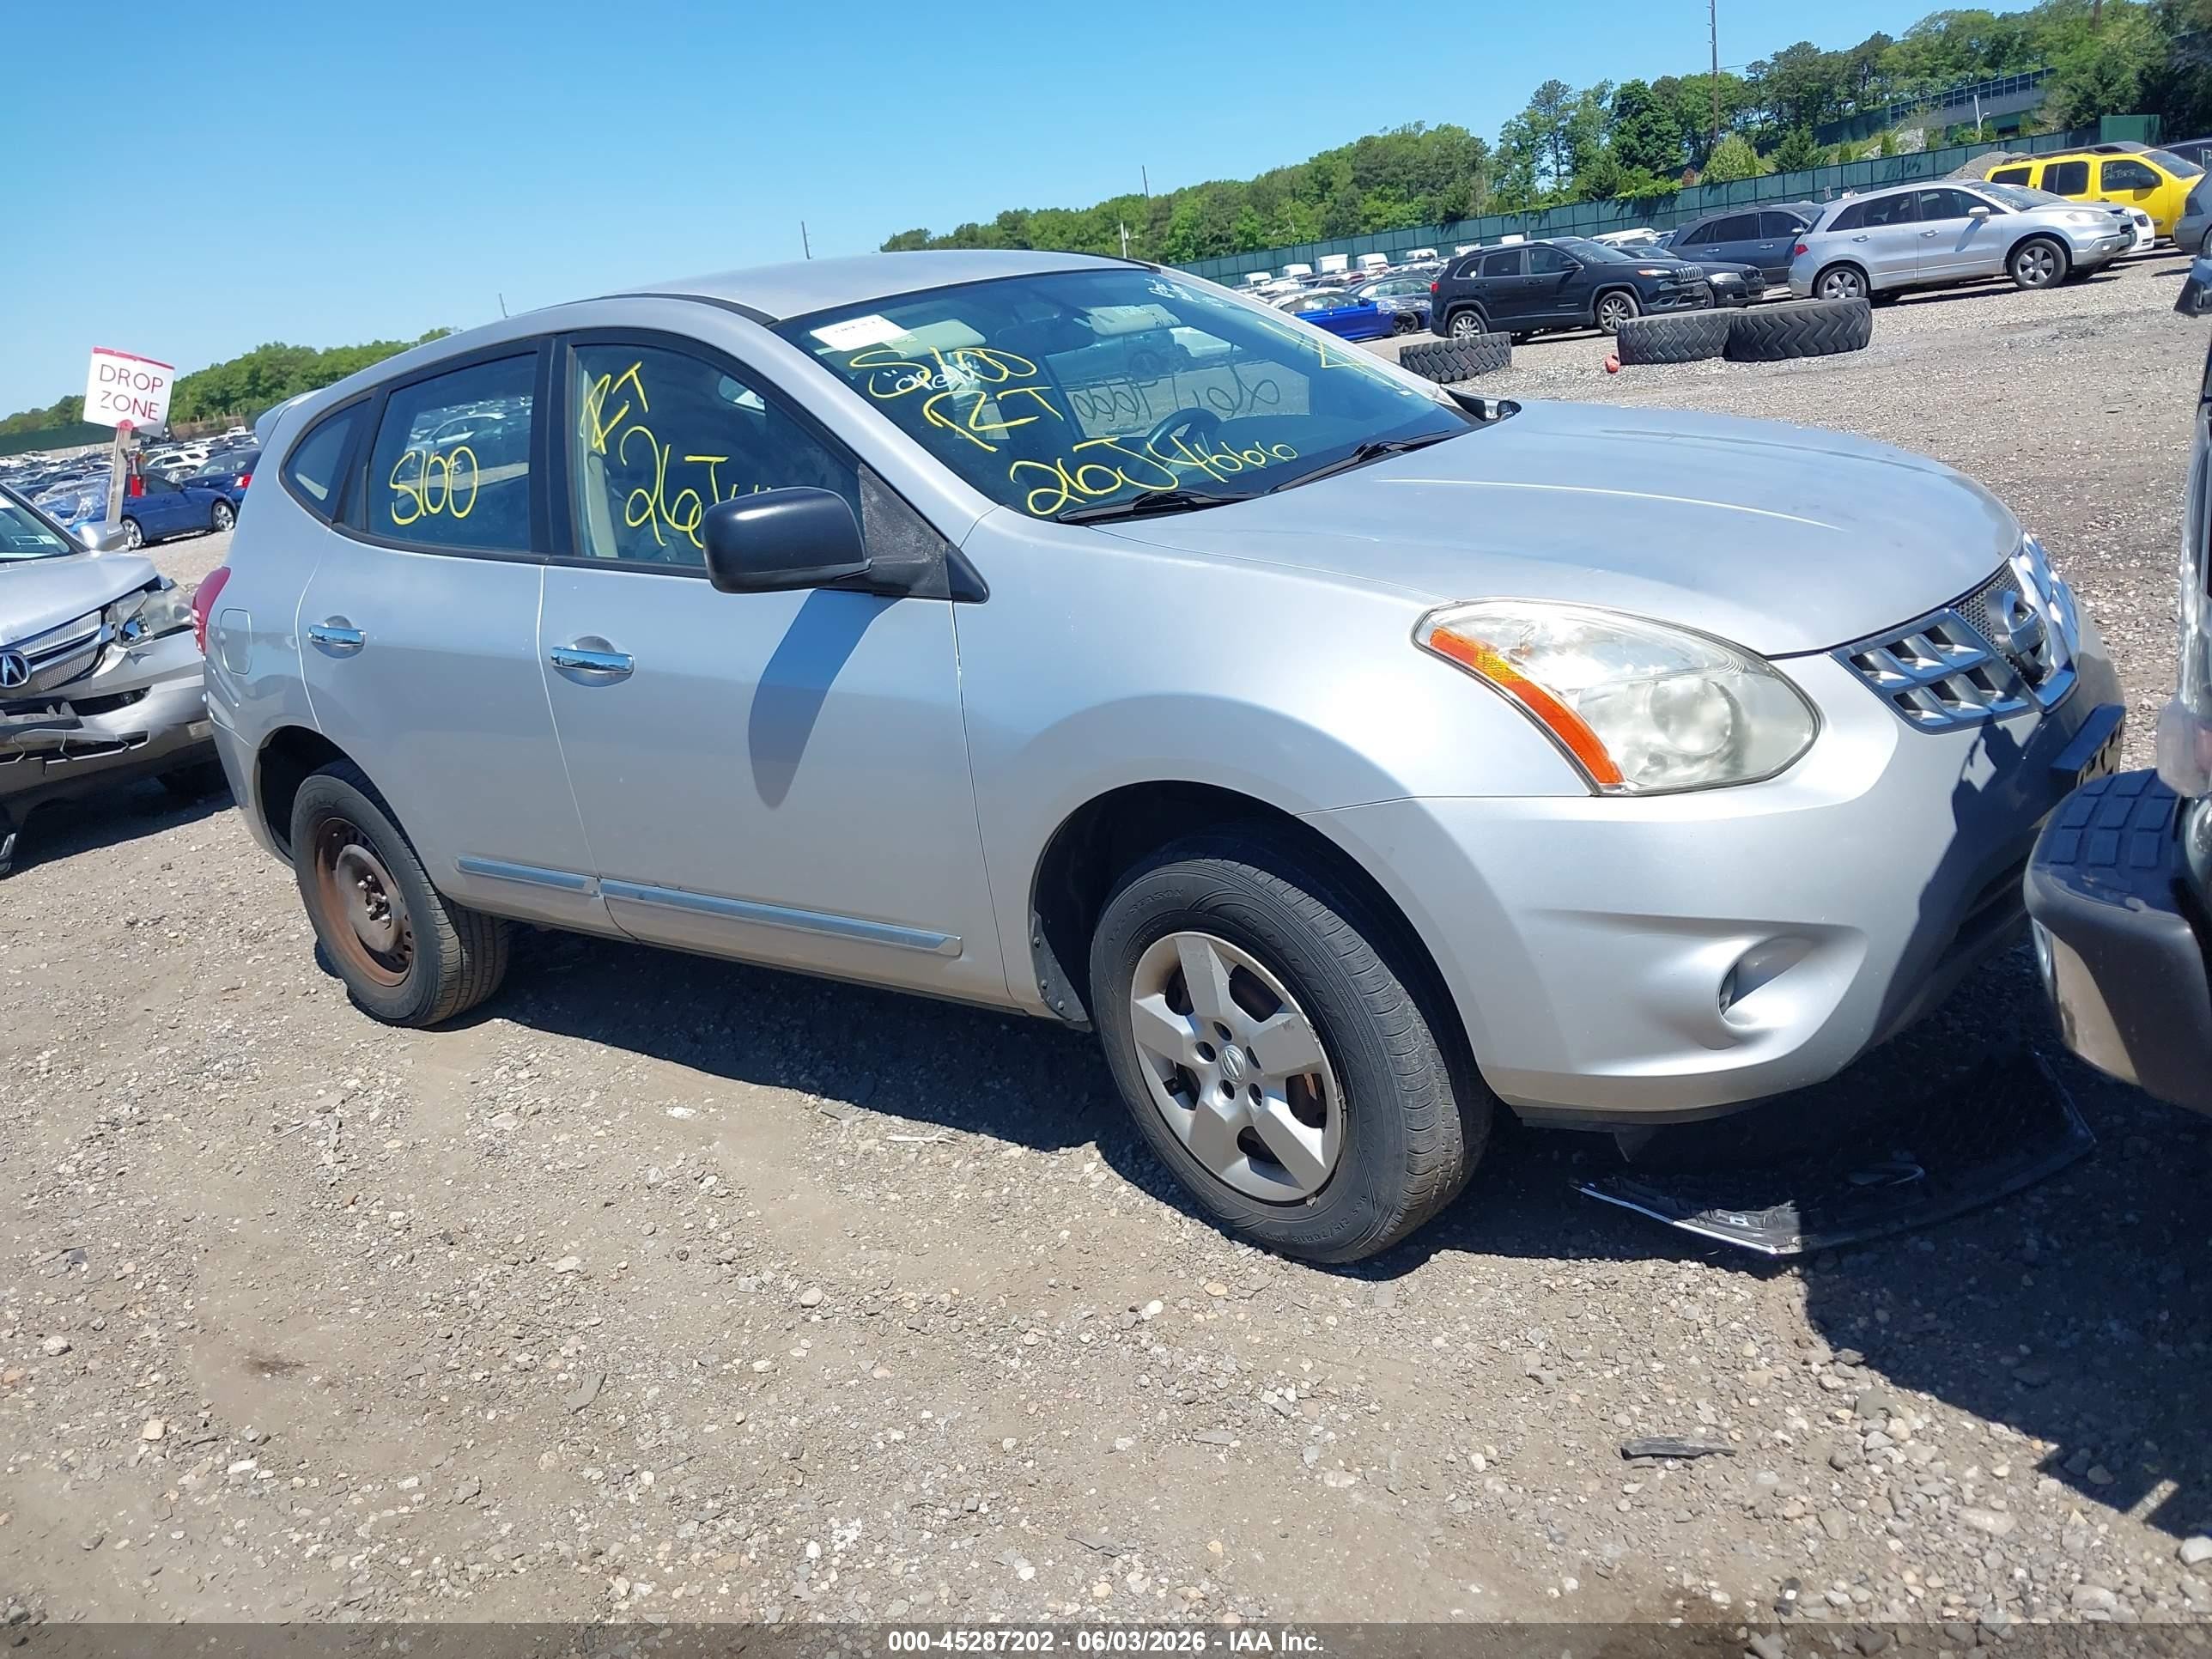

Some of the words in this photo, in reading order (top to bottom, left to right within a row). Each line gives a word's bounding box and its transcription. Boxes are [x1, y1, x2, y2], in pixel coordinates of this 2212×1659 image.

[100, 364, 164, 394] DROP
[100, 390, 161, 422] ZONE
[1009, 434, 1299, 516] 26J4666
